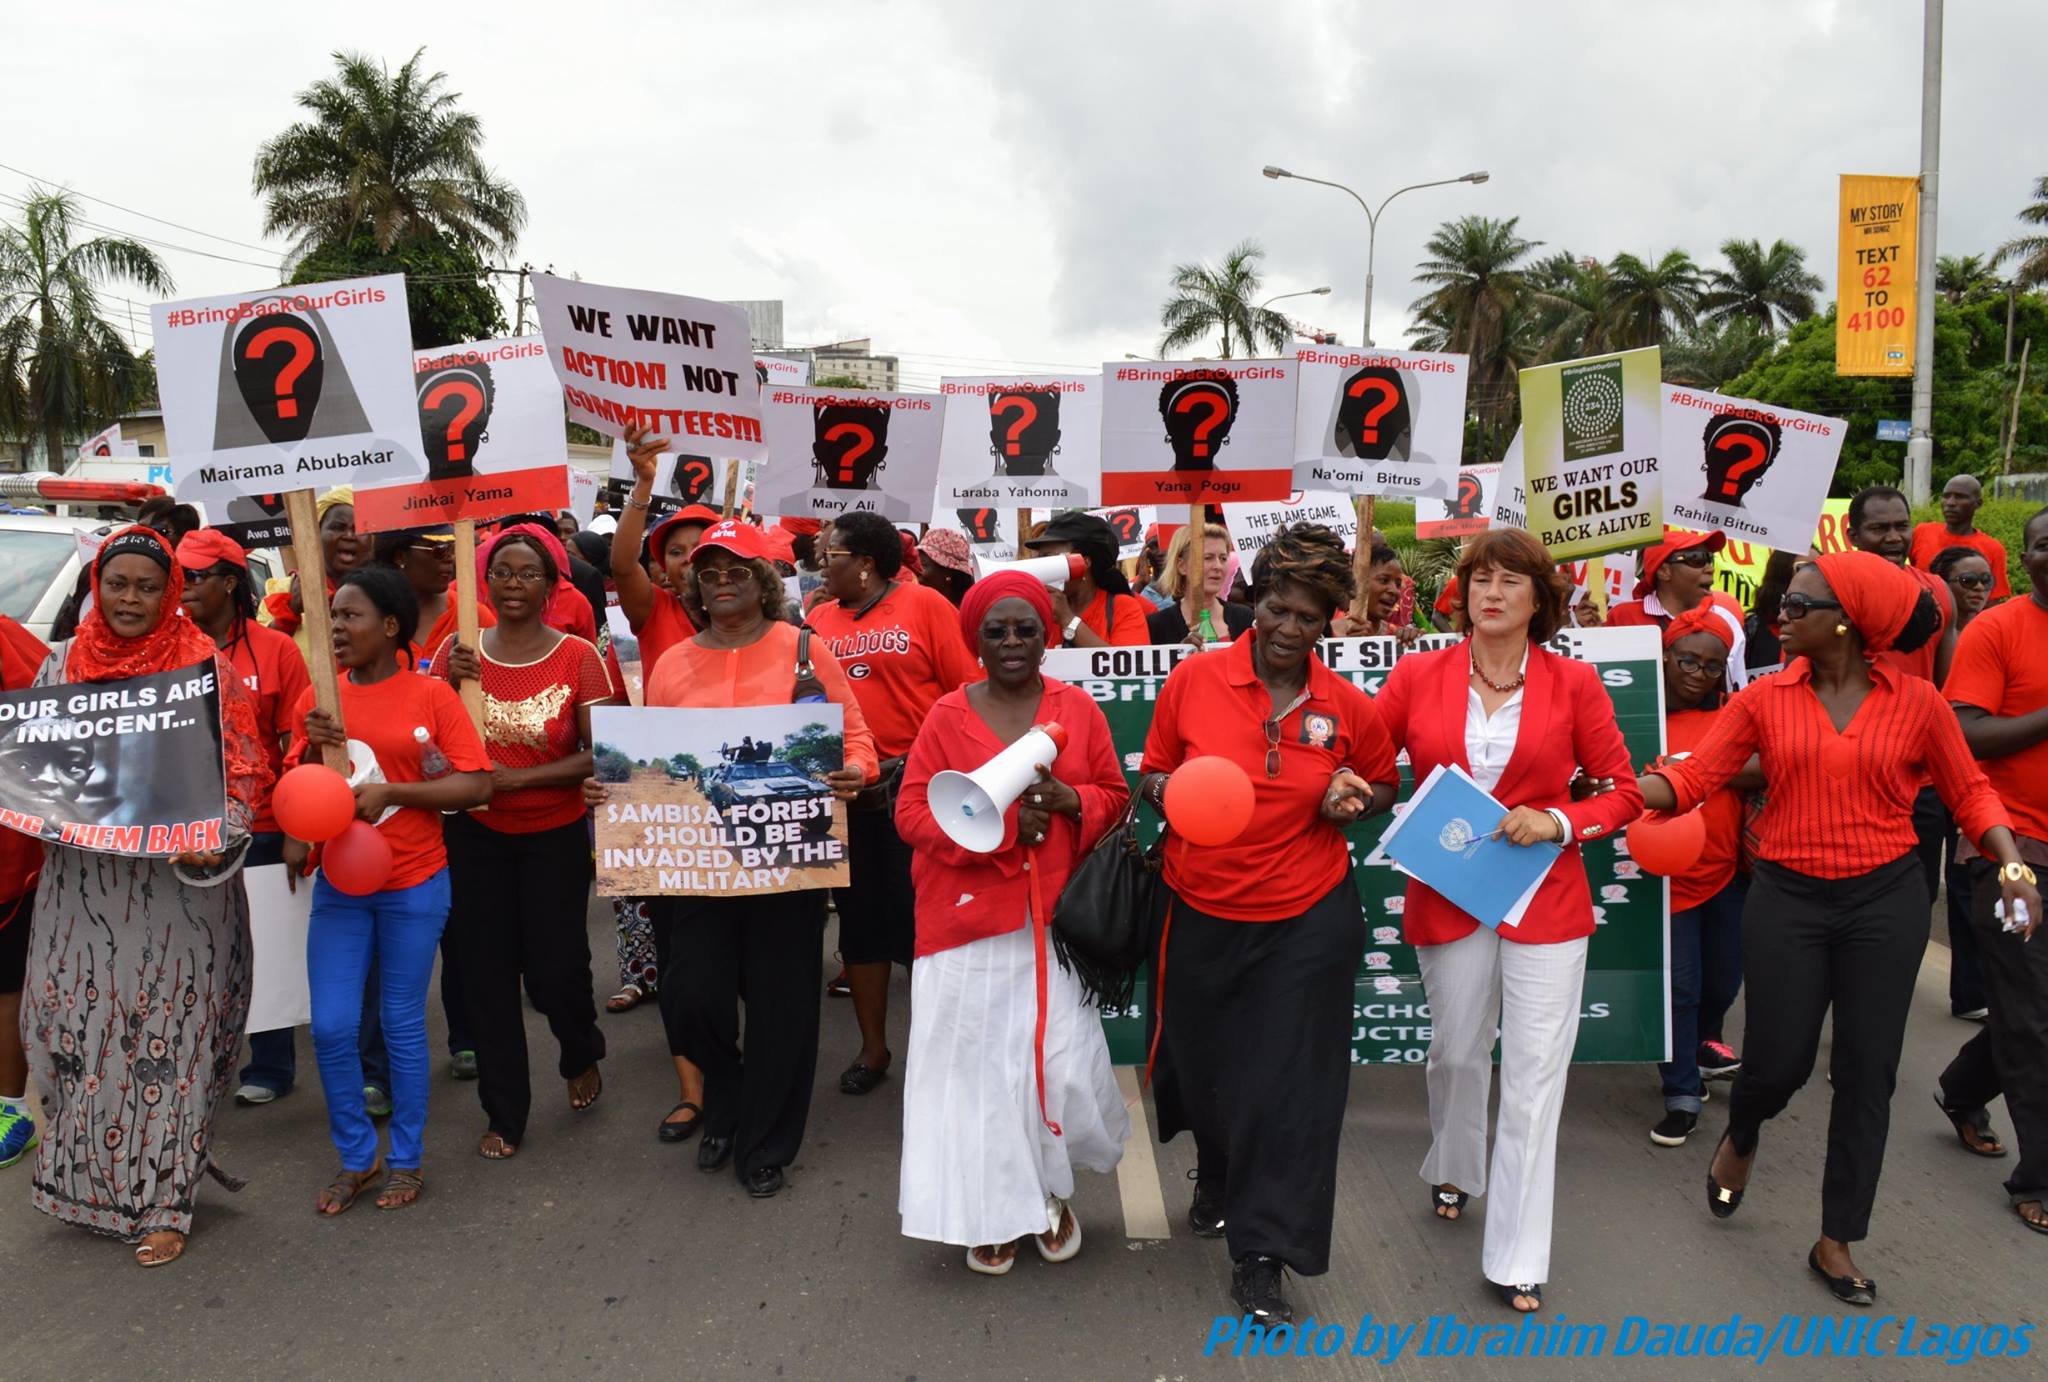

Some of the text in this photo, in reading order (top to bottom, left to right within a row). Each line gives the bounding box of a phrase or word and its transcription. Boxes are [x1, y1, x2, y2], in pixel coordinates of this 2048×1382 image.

[1850, 202, 1904, 223] MY STORY
[1856, 246, 1900, 265] TEXT
[1863, 266, 1891, 288] 62
[167, 287, 386, 328] #BringBackOurGirls
[1865, 290, 1888, 307] TO
[567, 304, 716, 349] WE WANT
[1847, 306, 1905, 333] 4100
[415, 342, 545, 374] BackOurGirls
[755, 360, 799, 374] OurGirls
[1296, 350, 1456, 374] #BringBackOurGirls
[562, 346, 739, 396] ACTION! NOT
[1116, 367, 1286, 384] #BringBackOurGirls
[772, 392, 932, 411] #BringBackOurGirls
[939, 381, 1086, 397] #BringBackOurGirls
[564, 383, 763, 443] COMMITTEES!!!
[1670, 391, 1832, 437] #BringBackOurGirls
[200, 450, 394, 484] Mairama Abubakar
[1312, 468, 1422, 487] Na'omi Bitrus
[1531, 457, 1659, 494] WE WANT OUR
[403, 486, 514, 511] Jinkai Yama
[953, 486, 1069, 499] Laraba Yahonna
[1154, 480, 1241, 495] Yana Pogu
[1513, 487, 1526, 505] TH
[812, 498, 875, 512] Mary Ali
[1553, 480, 1639, 521] GIRLS
[1246, 505, 1341, 529] THE BLAME GAME,
[1542, 512, 1652, 547] BACK ALIVE
[1673, 505, 1769, 536] Rahila Bitrus
[247, 525, 292, 540] Awa Bit
[711, 529, 737, 540] airtel
[1091, 648, 1196, 678] COLLE
[0, 698, 59, 722] OUR
[67, 687, 157, 715] GIRLS
[165, 673, 215, 704] ARE
[16, 710, 195, 744] INNOCENT...
[607, 796, 836, 825] SAMBISA FOREST
[0, 807, 223, 854] ING THEM BACK
[643, 822, 802, 847] SHOULD BE
[604, 840, 843, 869] INVADED BY THE
[658, 866, 791, 890] MILITARY
[1382, 1047, 1426, 1063] 20
